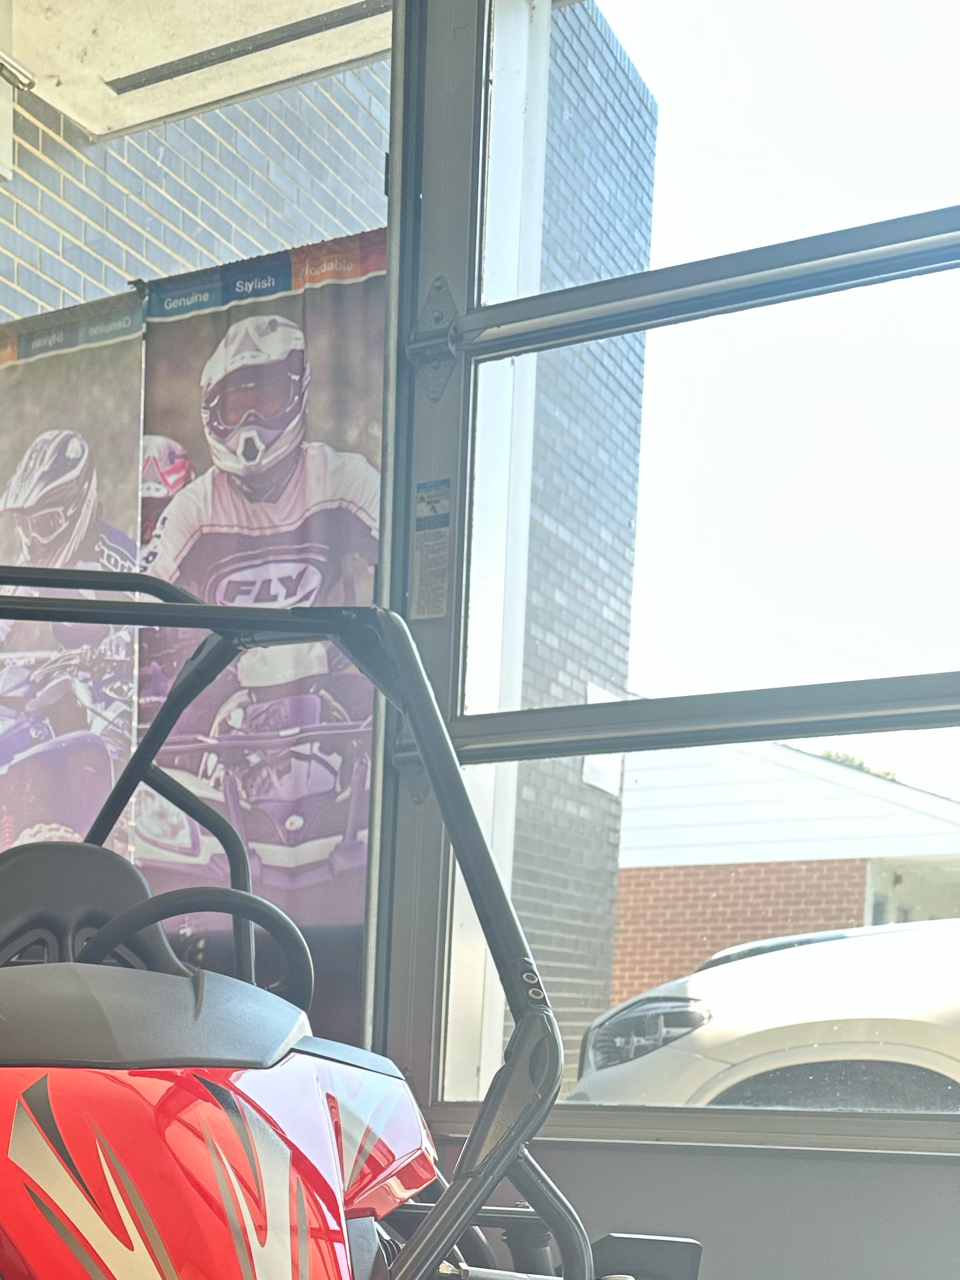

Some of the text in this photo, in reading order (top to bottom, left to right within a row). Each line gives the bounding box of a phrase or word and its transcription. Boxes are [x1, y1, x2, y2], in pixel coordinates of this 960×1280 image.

[164, 292, 210, 310] Genuine
[235, 275, 276, 293] Stylish
[222, 565, 309, 604] FLY
